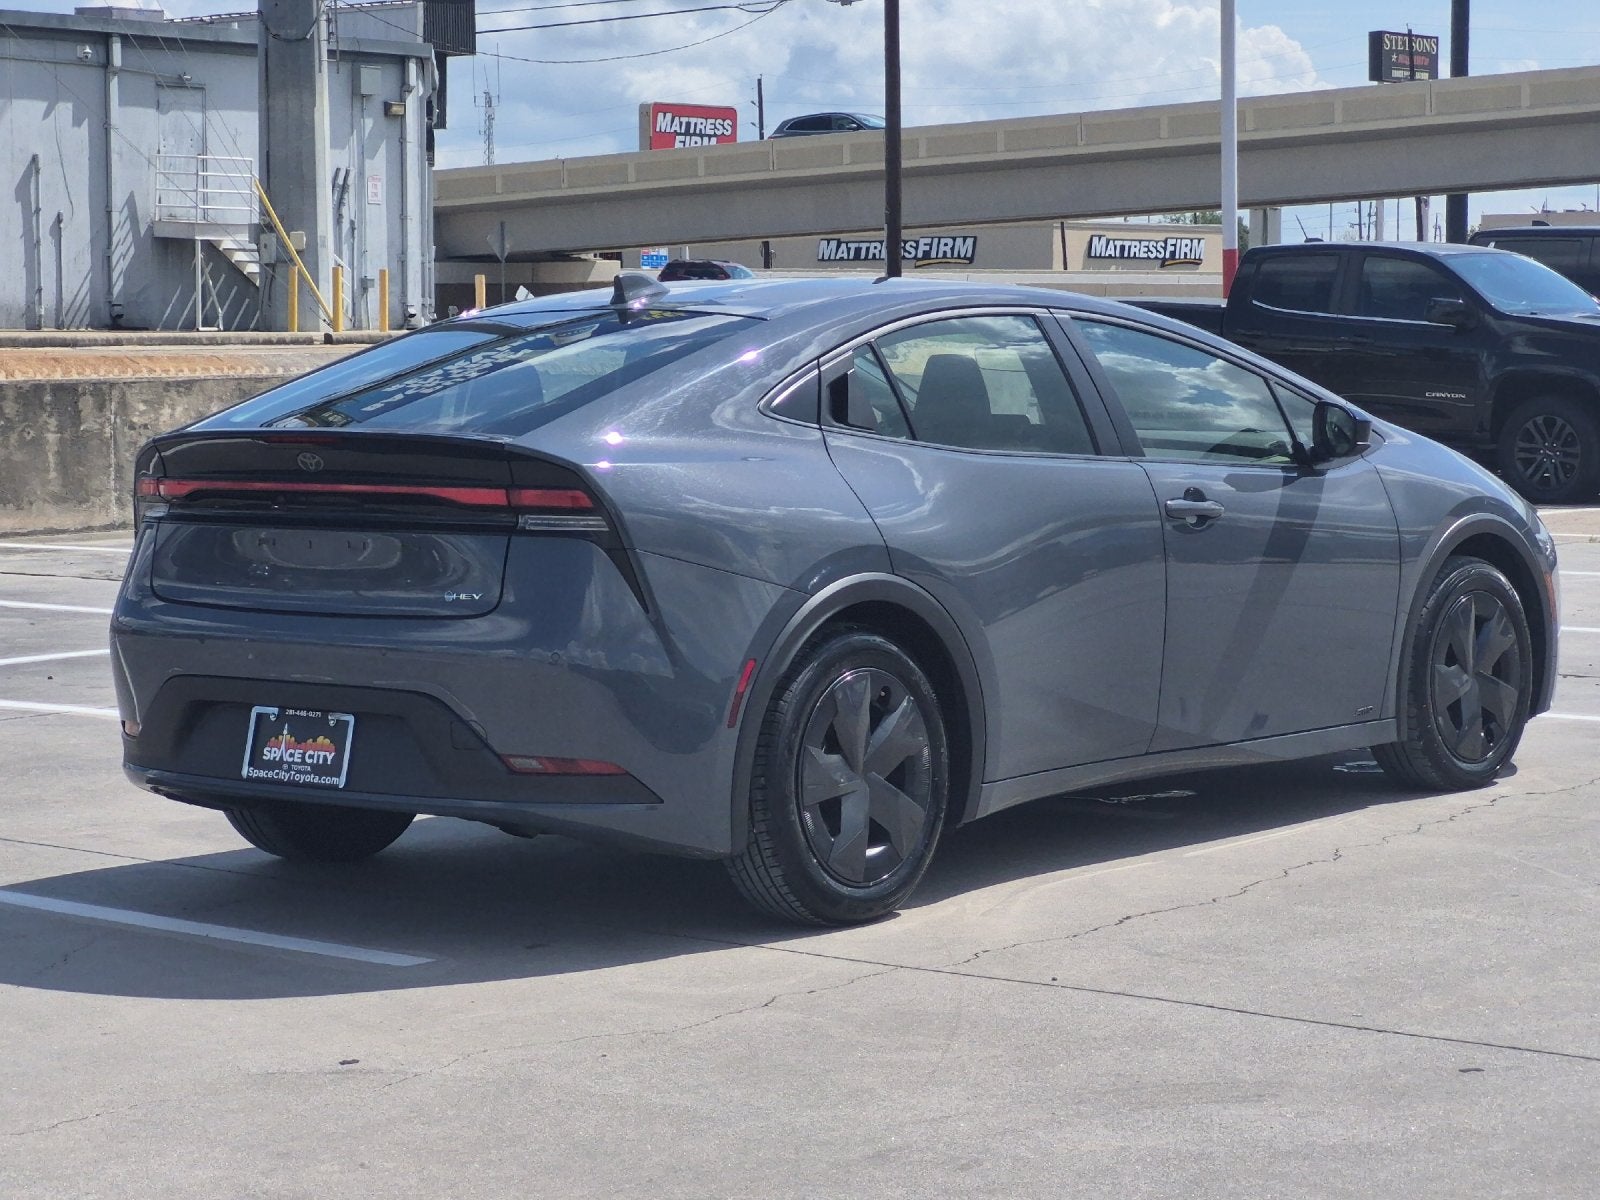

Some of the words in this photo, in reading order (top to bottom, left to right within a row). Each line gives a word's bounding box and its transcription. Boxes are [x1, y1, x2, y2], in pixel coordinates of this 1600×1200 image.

[1383, 34, 1437, 54] STETSONS
[655, 112, 733, 136] MATTRESS
[1425, 391, 1466, 399] CANYON
[453, 592, 484, 600] HEV
[263, 747, 303, 763] SPACE
[304, 750, 336, 765] CITY
[248, 767, 340, 785] SpaceCityToyota.com
[291, 764, 312, 772] TOYOTA
